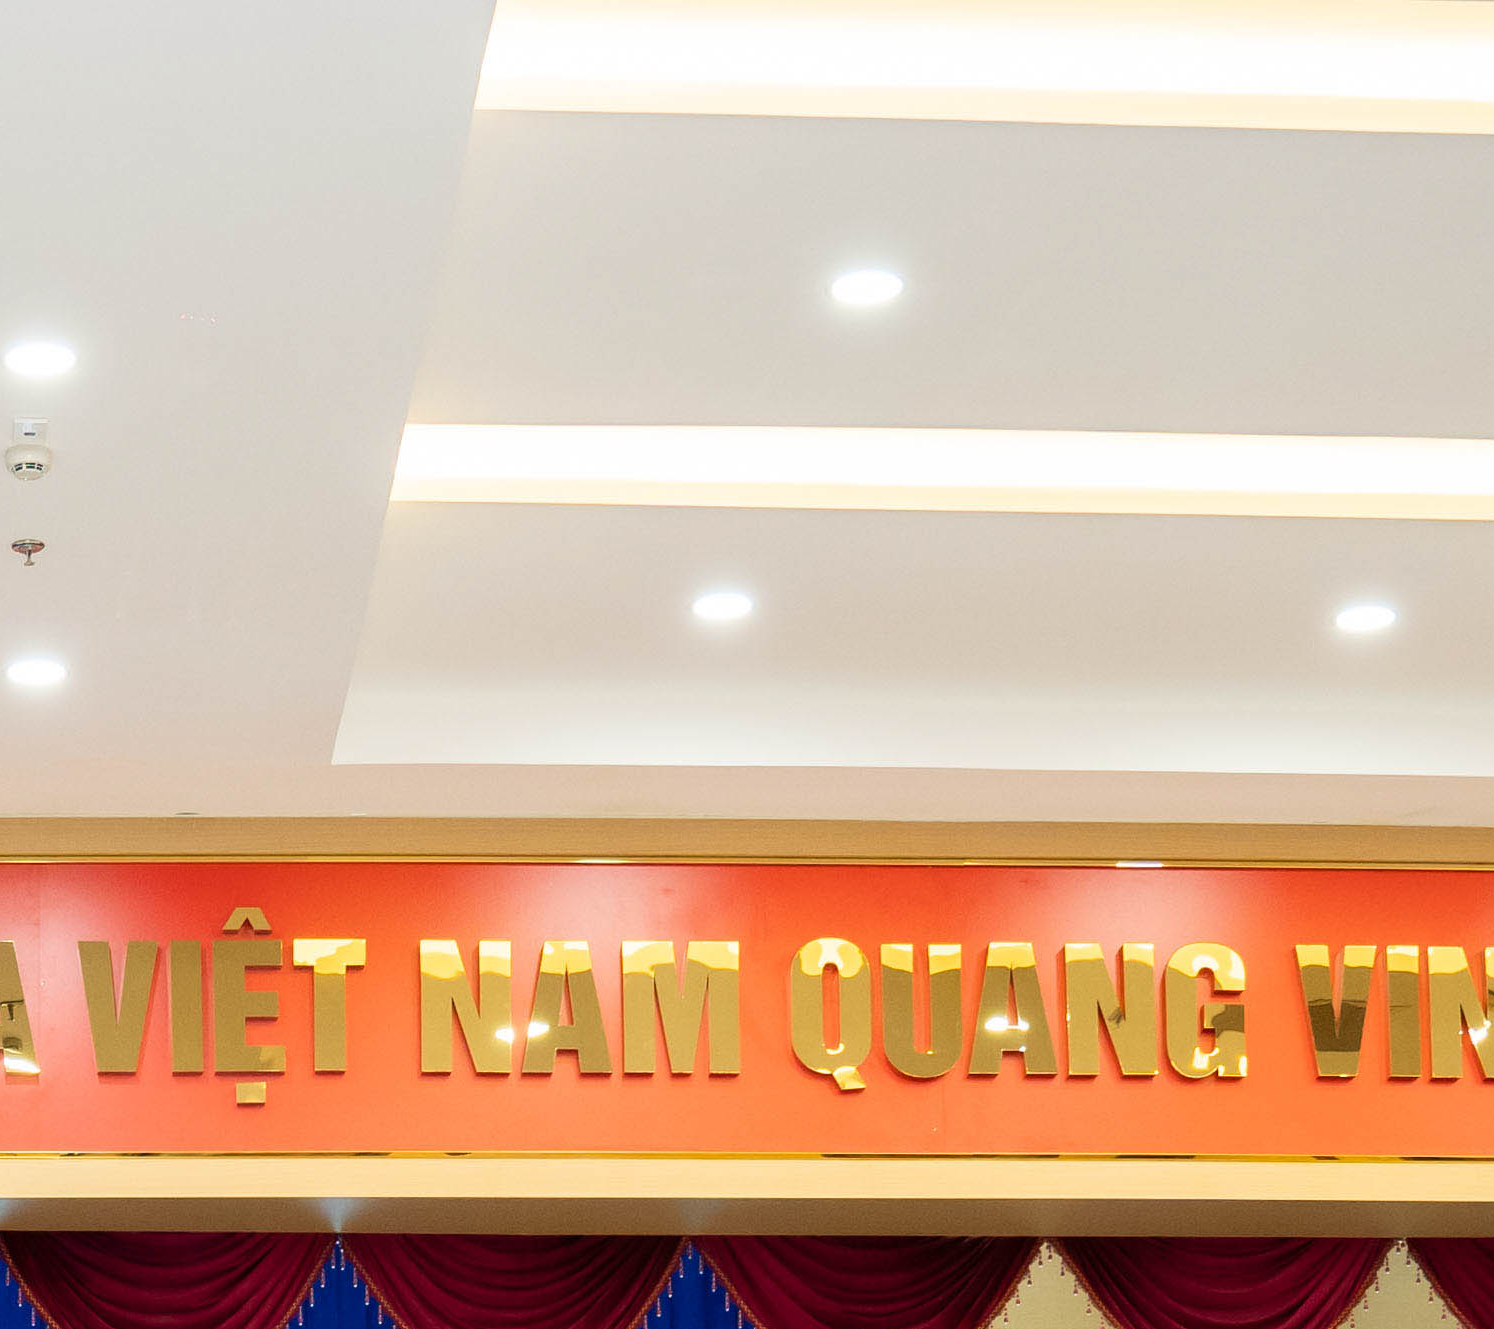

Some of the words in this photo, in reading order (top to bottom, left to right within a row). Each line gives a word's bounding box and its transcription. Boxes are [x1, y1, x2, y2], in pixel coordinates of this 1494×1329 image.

[77, 907, 368, 1104] VIỆT
[419, 939, 740, 1075] NAM
[789, 937, 1247, 1091] QUANG
